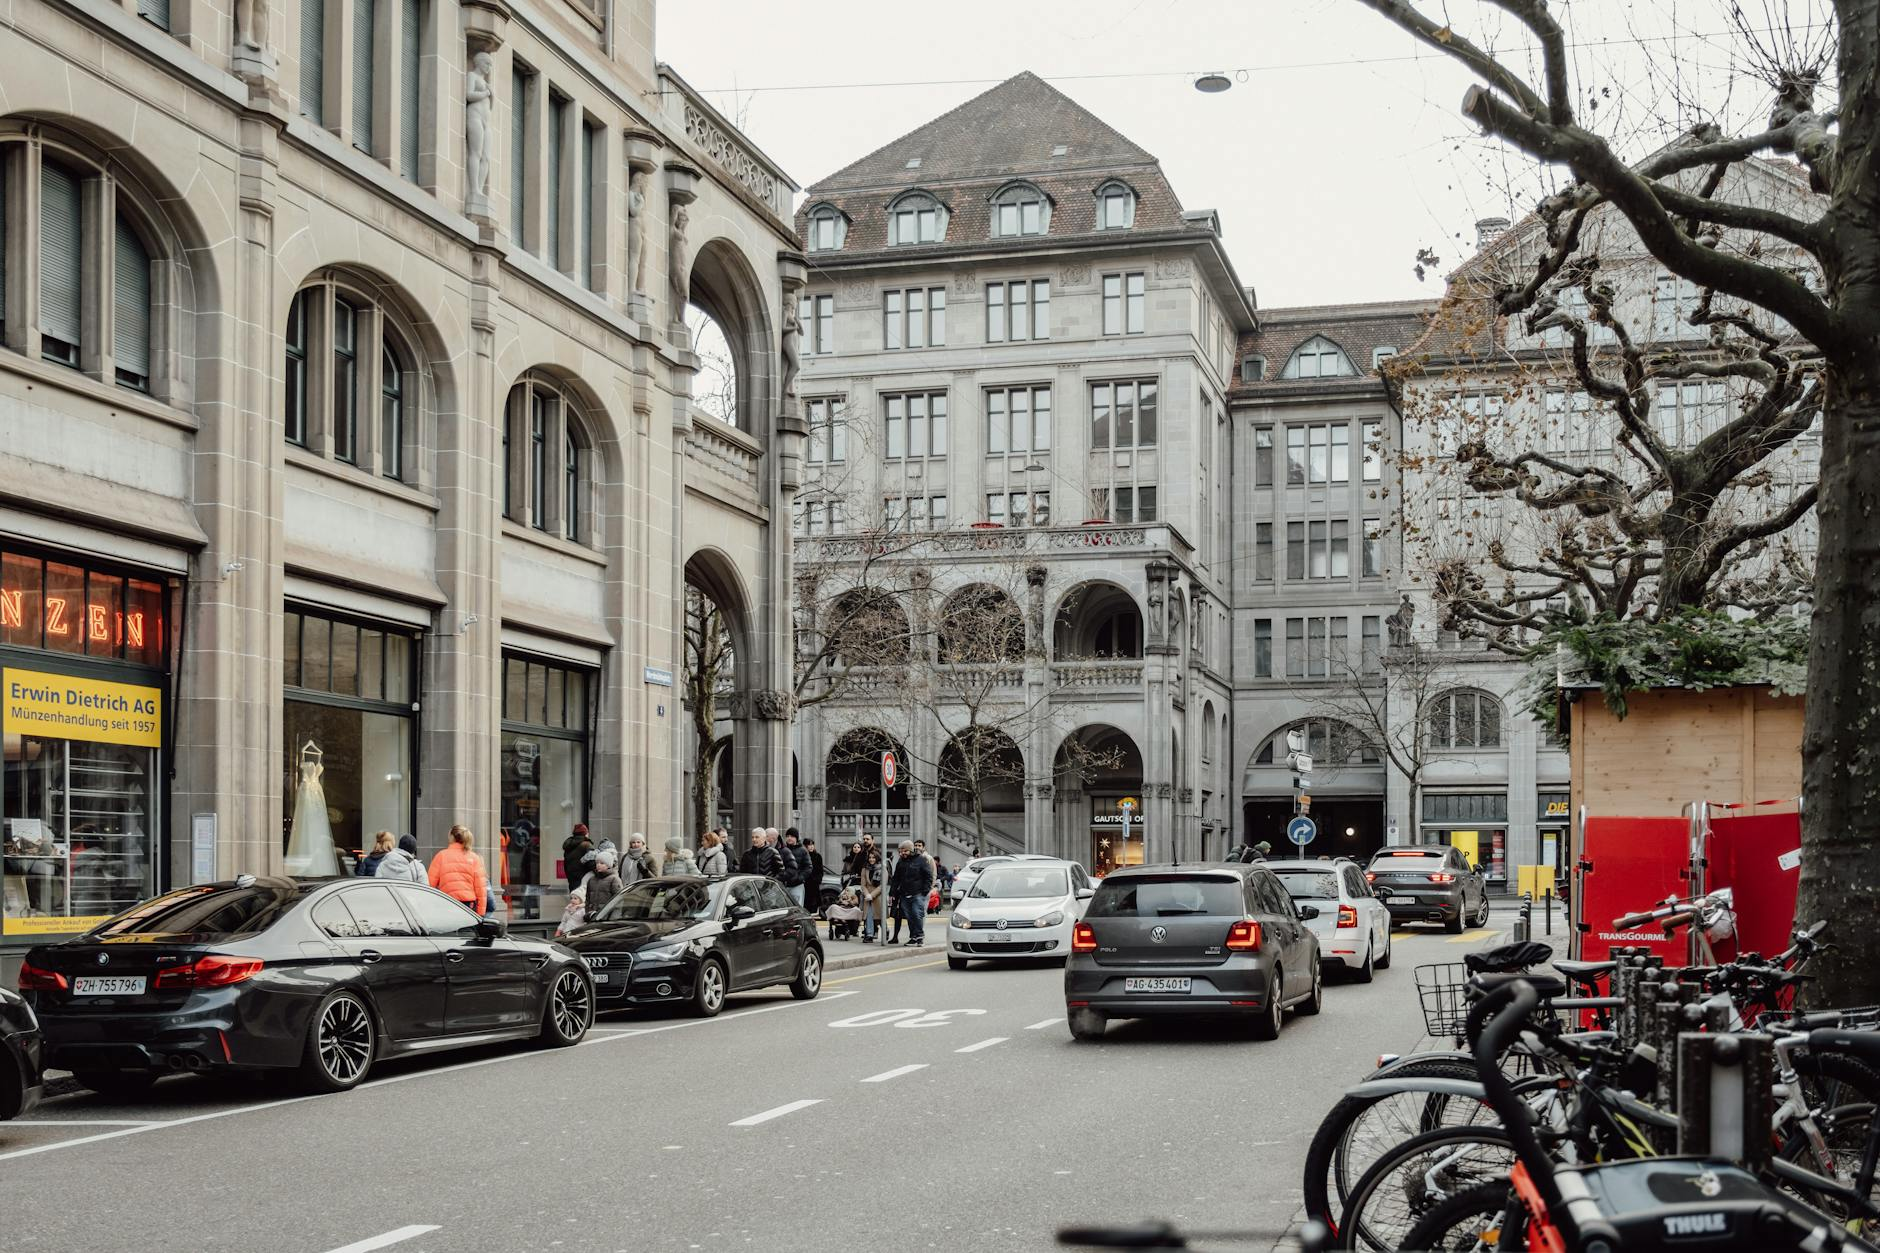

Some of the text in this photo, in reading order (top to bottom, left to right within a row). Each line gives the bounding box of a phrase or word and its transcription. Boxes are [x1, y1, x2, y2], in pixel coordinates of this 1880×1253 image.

[11, 682, 155, 715] Erwin Dietrich AG
[11, 706, 155, 733] Münzenhandlung seit 1957
[1664, 1213, 1726, 1234] THULE
